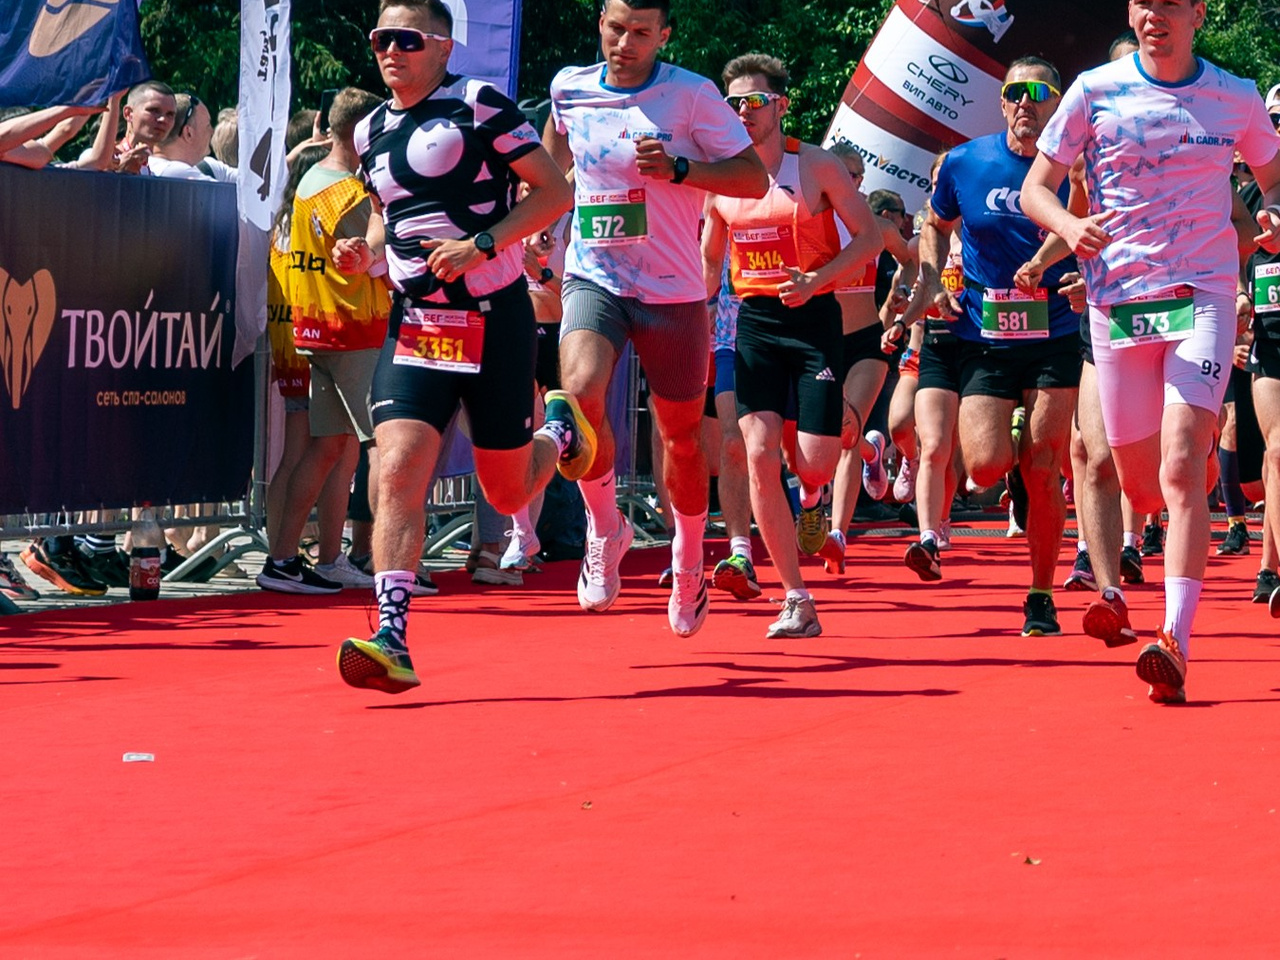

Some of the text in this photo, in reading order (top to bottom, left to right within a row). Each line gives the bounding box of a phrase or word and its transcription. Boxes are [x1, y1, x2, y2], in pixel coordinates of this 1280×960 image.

[906, 61, 974, 107] CHERY
[902, 80, 959, 120] ВИП АВТО
[590, 194, 607, 204] БЕГ
[592, 215, 626, 238] 572
[746, 250, 782, 270] 3414
[61, 288, 224, 370] ТВОЙТАЙ
[423, 313, 443, 323] БЕГ
[997, 311, 1029, 331] 581
[1131, 311, 1170, 336] 573
[412, 335, 464, 362] 3351
[1201, 359, 1222, 381] 92
[96, 390, 187, 406] сеть спа-салонов
